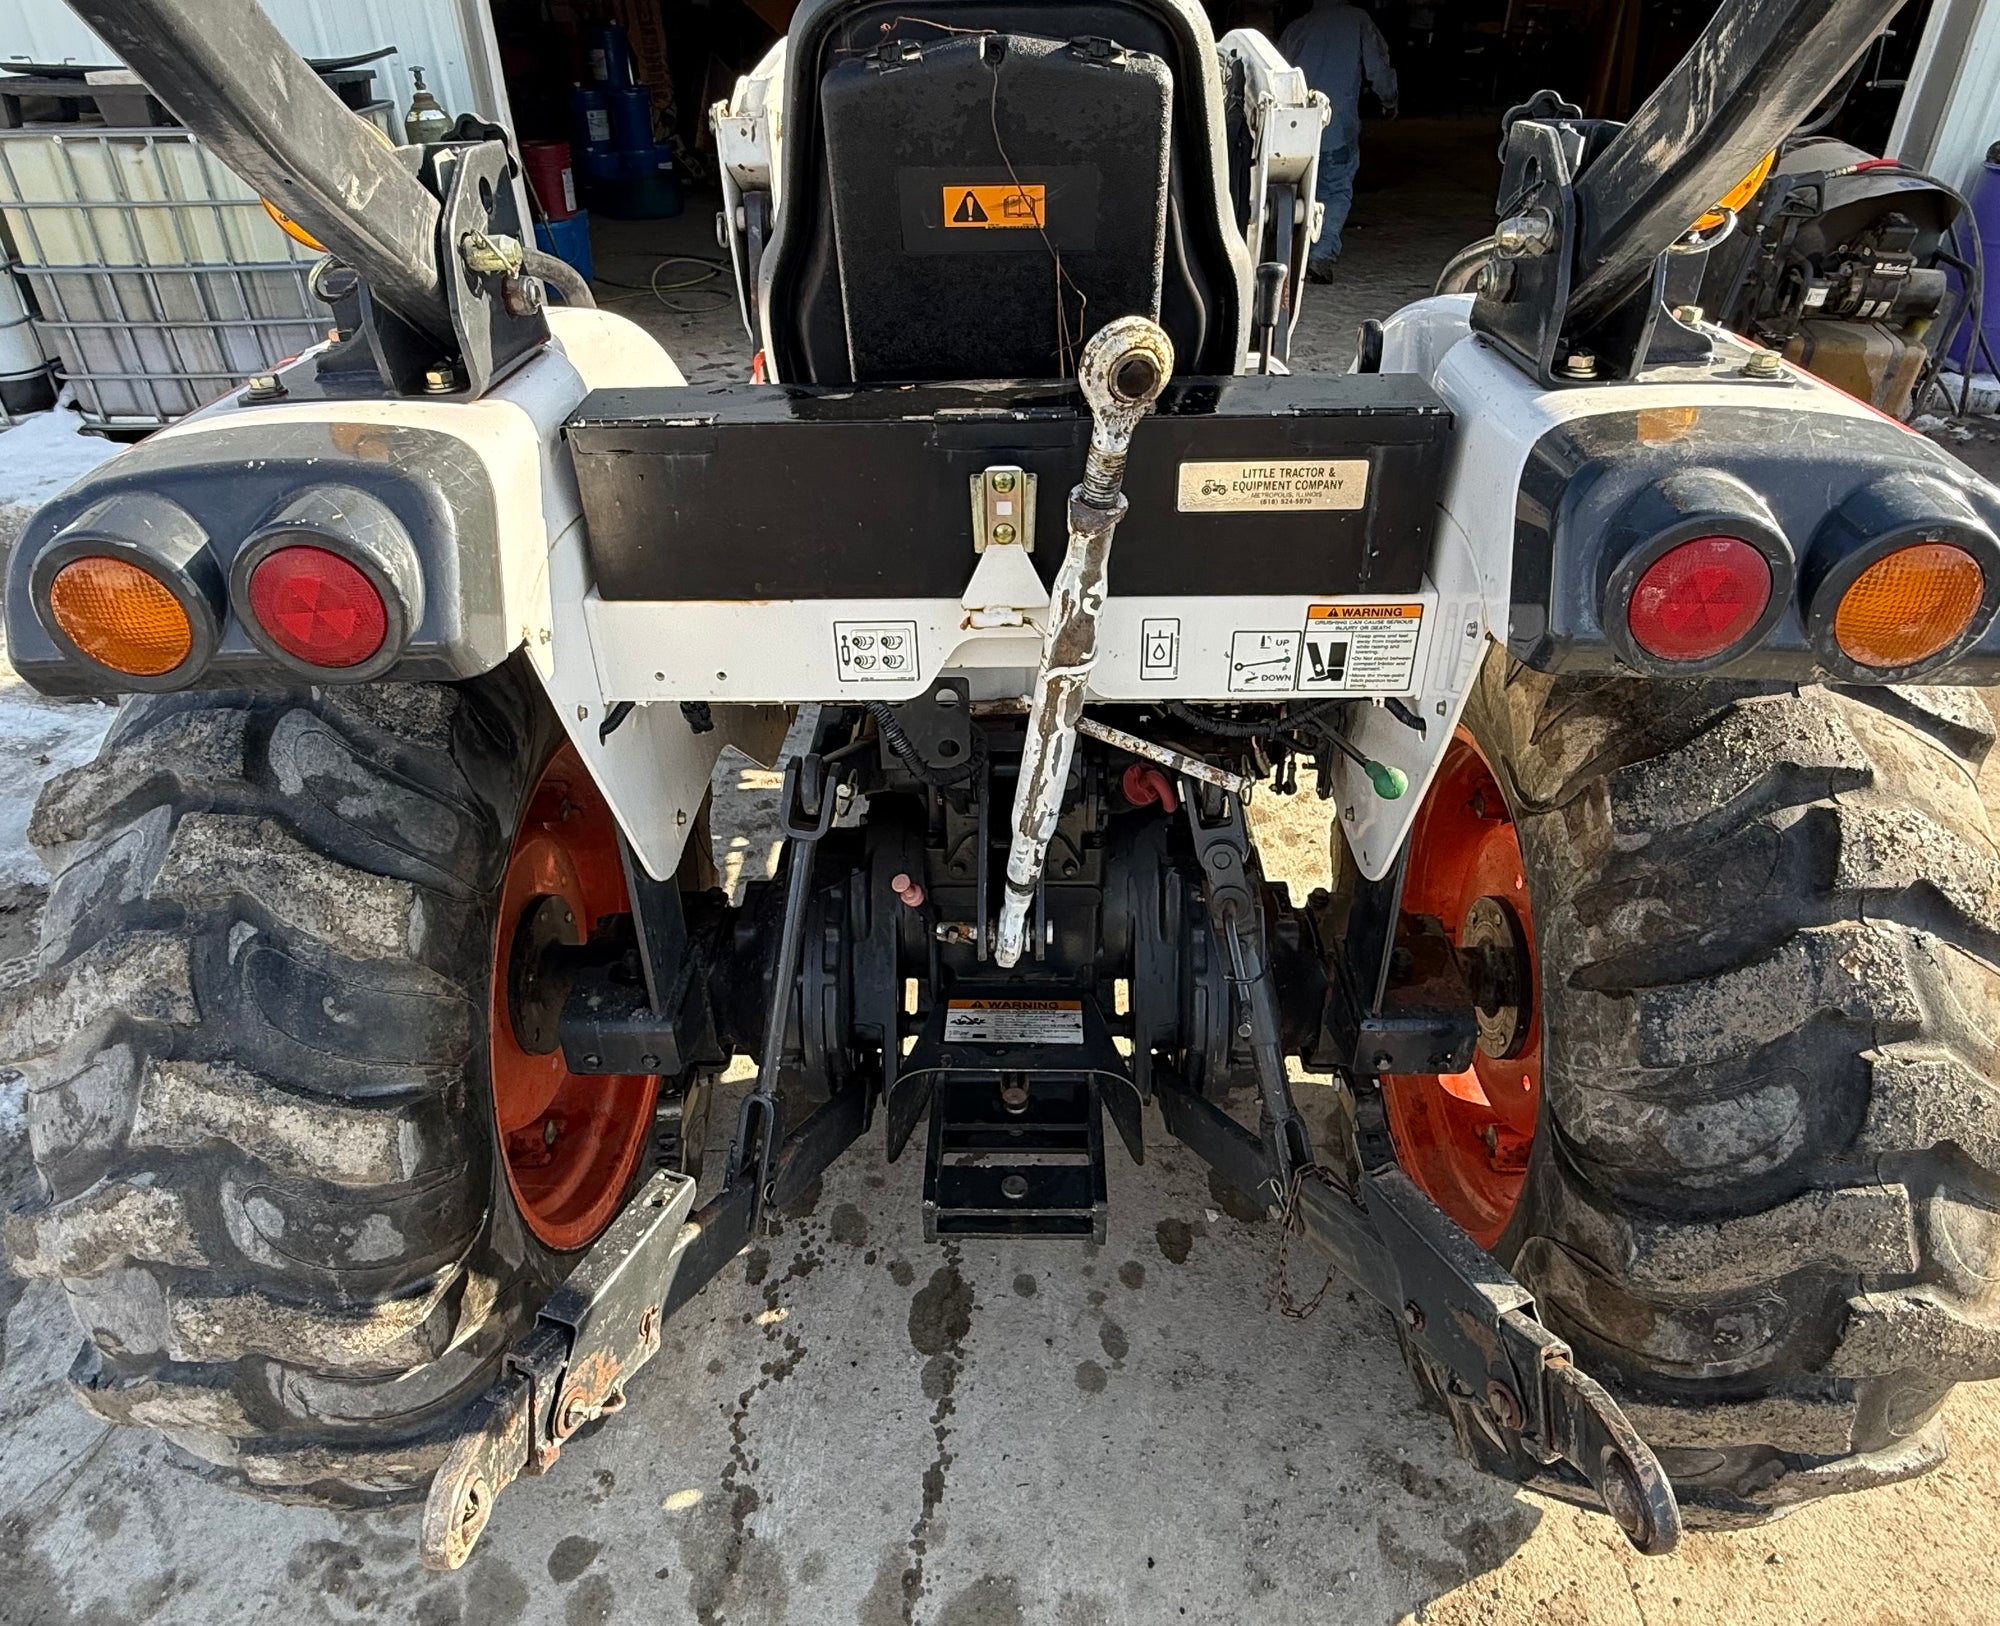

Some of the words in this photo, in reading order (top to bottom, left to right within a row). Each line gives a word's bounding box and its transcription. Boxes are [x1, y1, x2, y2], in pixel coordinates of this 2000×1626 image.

[1242, 468, 1276, 478] LITTLE
[1279, 467, 1325, 478] TRACTOR
[1328, 467, 1336, 478] &
[1232, 481, 1292, 492] EQUIPMENT
[1295, 480, 1344, 491] COMPANY
[1342, 607, 1403, 617] WARNING
[1261, 674, 1292, 682] DOWN
[987, 1001, 1059, 1010] WARNING
